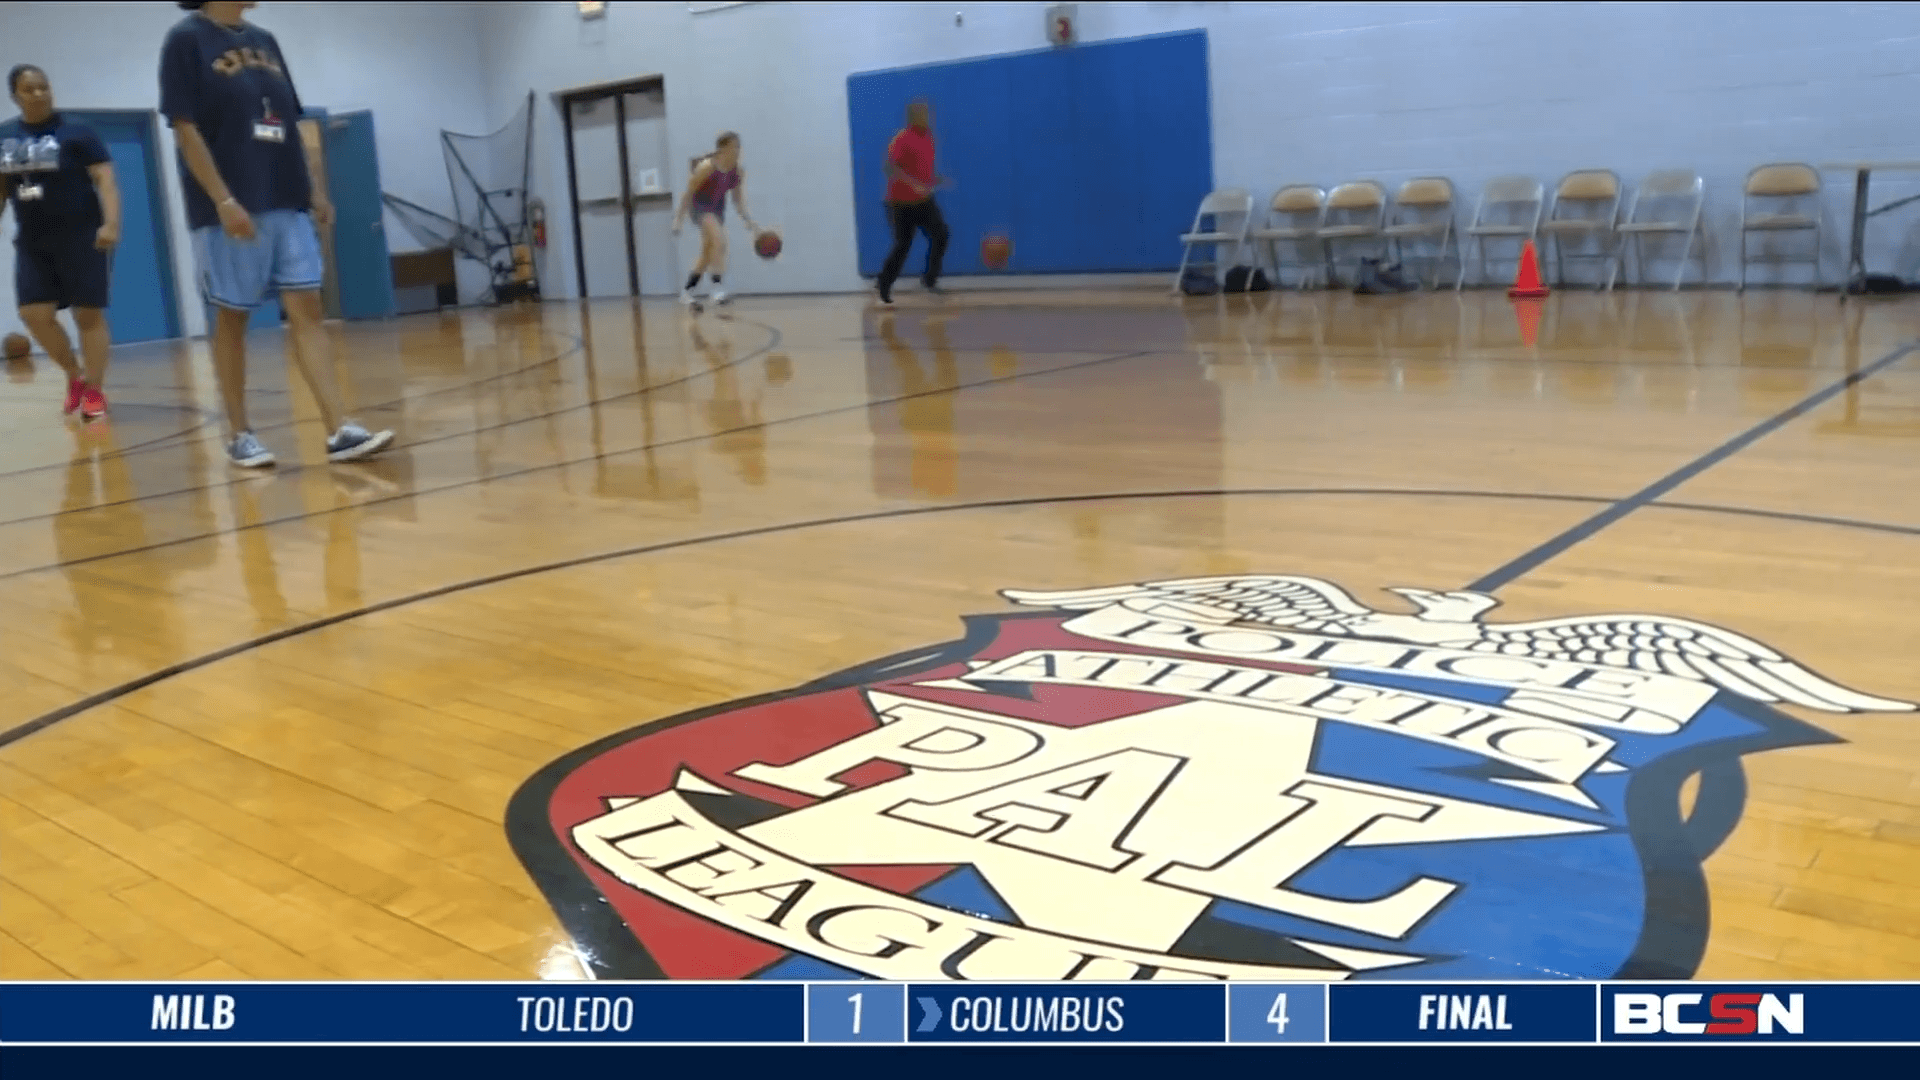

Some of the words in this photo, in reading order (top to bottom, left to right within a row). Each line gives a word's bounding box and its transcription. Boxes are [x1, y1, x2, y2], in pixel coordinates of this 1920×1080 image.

[987, 653, 1601, 764] ATHLETIC
[1103, 619, 1652, 699] POLICE
[736, 704, 1460, 939] PAL
